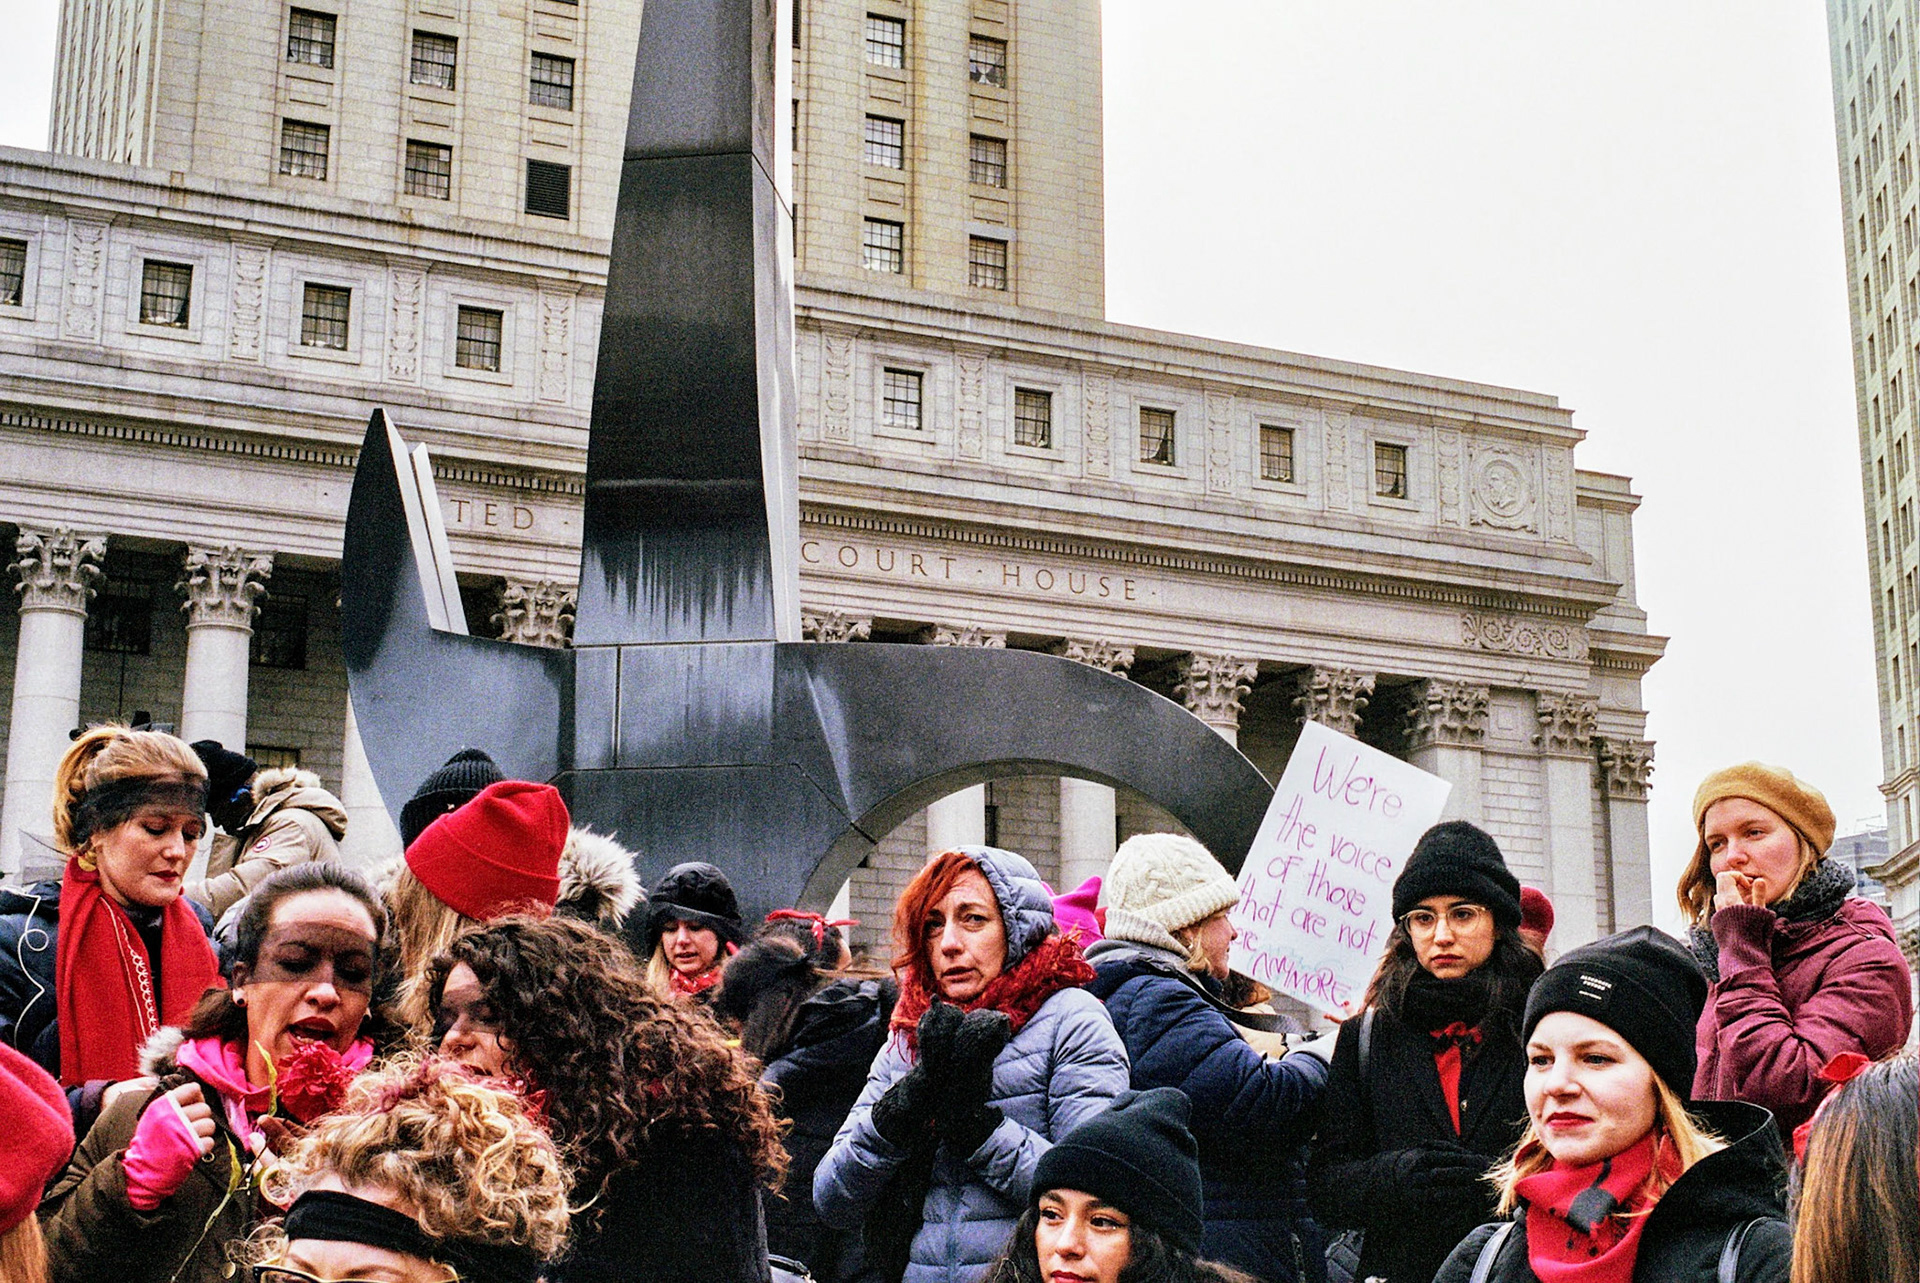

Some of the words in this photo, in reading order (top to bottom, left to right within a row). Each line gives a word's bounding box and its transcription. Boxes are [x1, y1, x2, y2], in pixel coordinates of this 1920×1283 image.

[450, 499, 534, 530] TED
[801, 541, 957, 579] COURT
[1002, 564, 1136, 601] HOUSE
[1313, 745, 1402, 818] We're
[1277, 793, 1317, 851] the
[1330, 833, 1392, 883] voice
[1234, 873, 1283, 929] that
[1291, 907, 1327, 938] are
[1338, 919, 1378, 955] not
[1307, 858, 1366, 916] those
